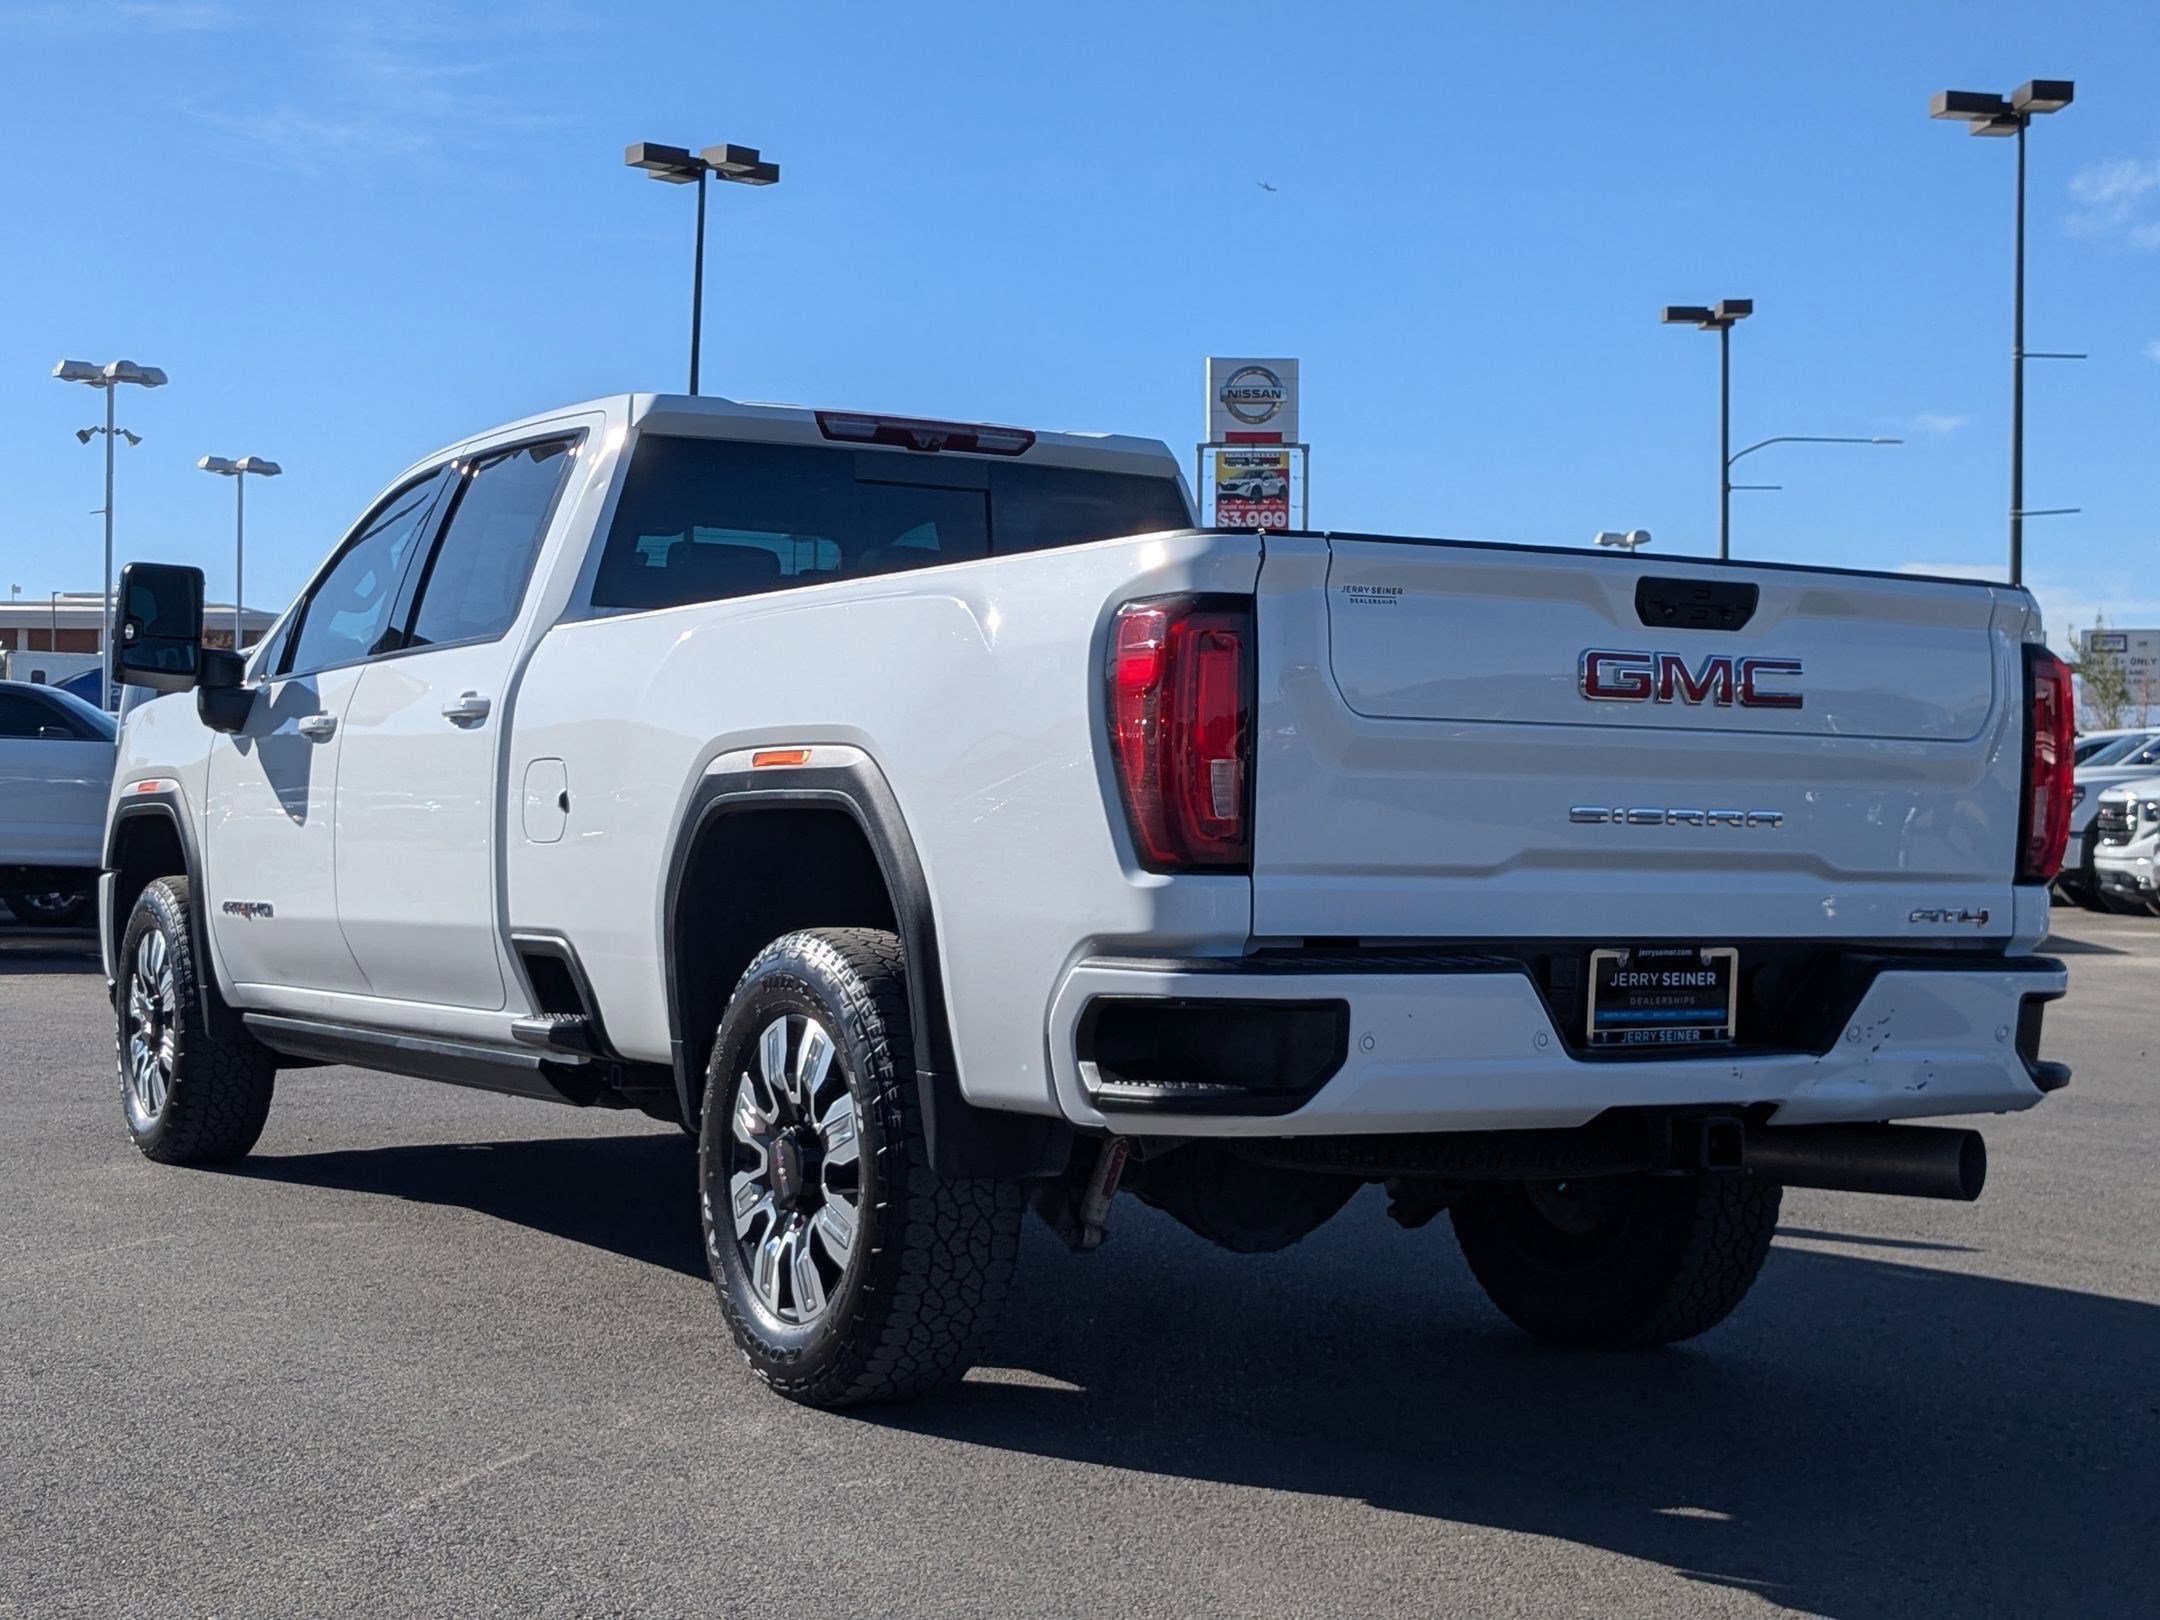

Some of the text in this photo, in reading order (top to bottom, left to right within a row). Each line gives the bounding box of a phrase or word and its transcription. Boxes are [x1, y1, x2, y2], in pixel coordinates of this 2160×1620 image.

[1227, 389, 1282, 399] NISSAN
[1341, 585, 1404, 595] JERRY SEINER
[1578, 647, 1803, 710] GMC
[1569, 805, 1784, 828] SIERRA
[1638, 949, 1693, 957] jerryseiner.com
[1610, 972, 1717, 987] JERRY SEINER
[1630, 996, 1696, 1006] DEALERSHIPS
[1621, 1030, 1701, 1044] JERRY SEINER
